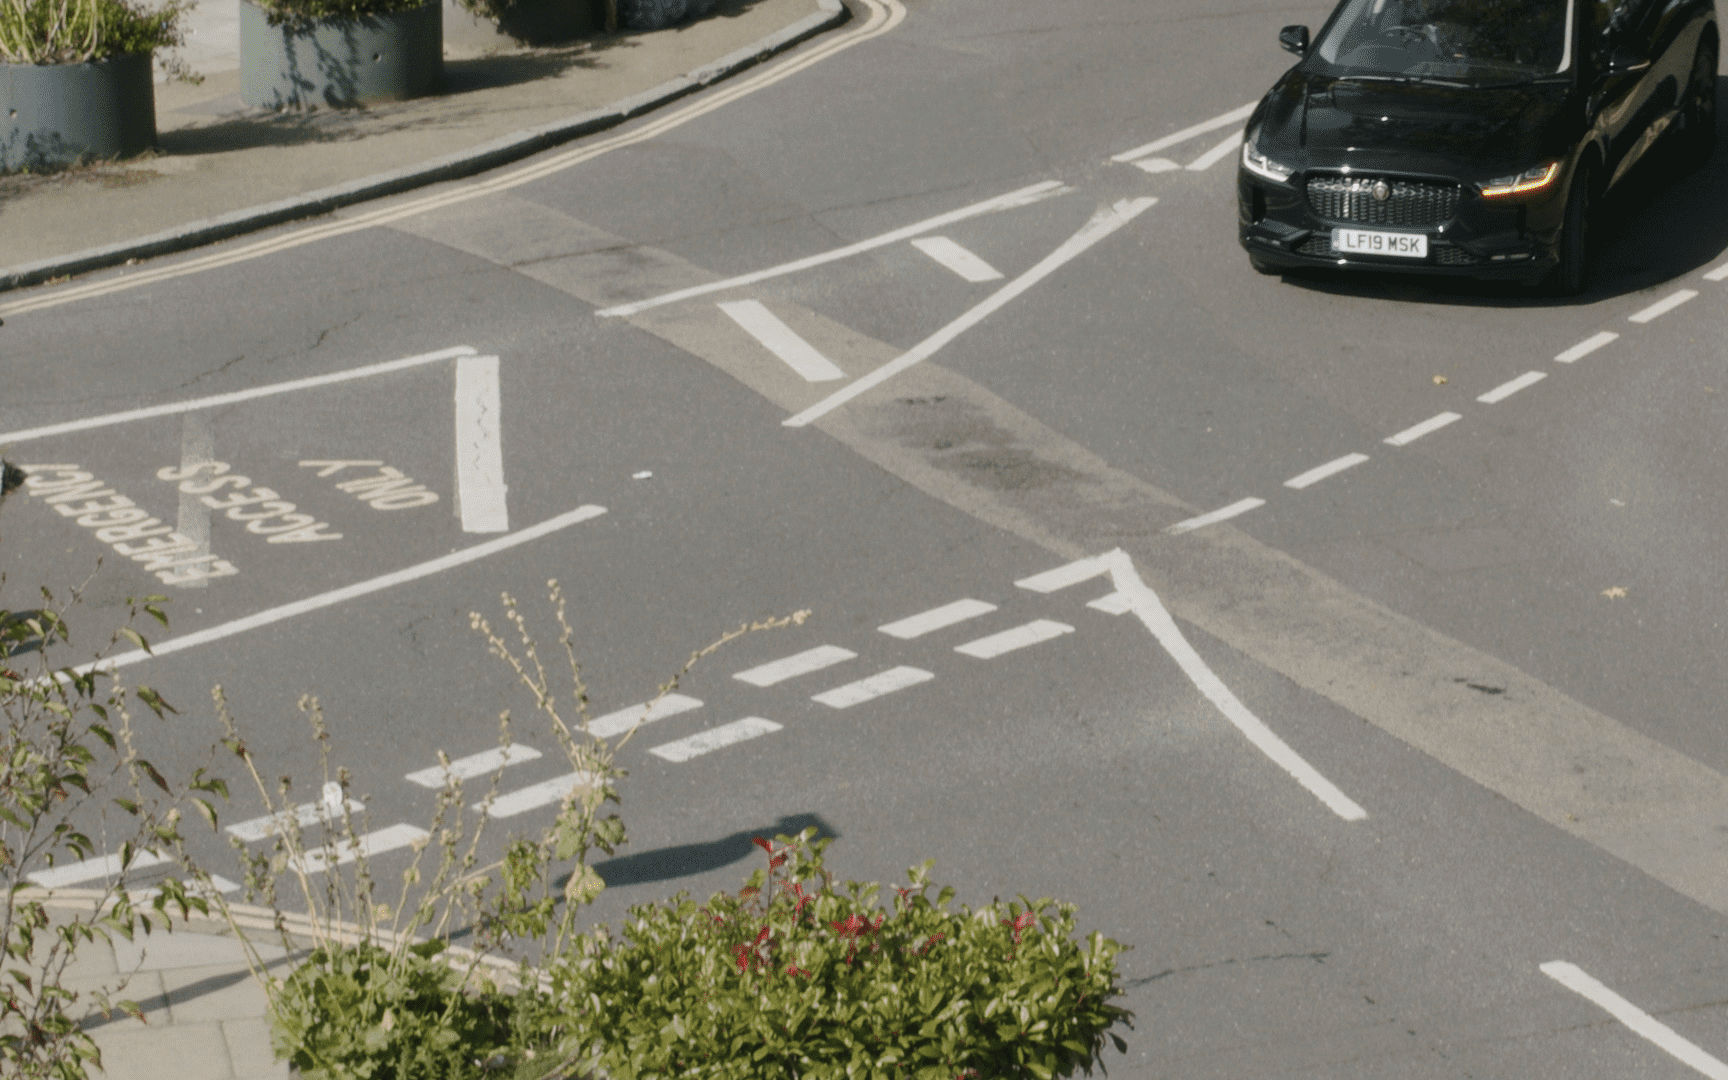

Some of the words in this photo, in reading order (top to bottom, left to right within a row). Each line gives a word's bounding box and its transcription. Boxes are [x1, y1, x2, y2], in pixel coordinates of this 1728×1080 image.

[1347, 233, 1383, 250] LF19
[1388, 235, 1420, 253] MSK
[156, 460, 344, 544] ACCESS
[298, 459, 440, 511] ONLY
[21, 463, 240, 585] EMERGENCY
